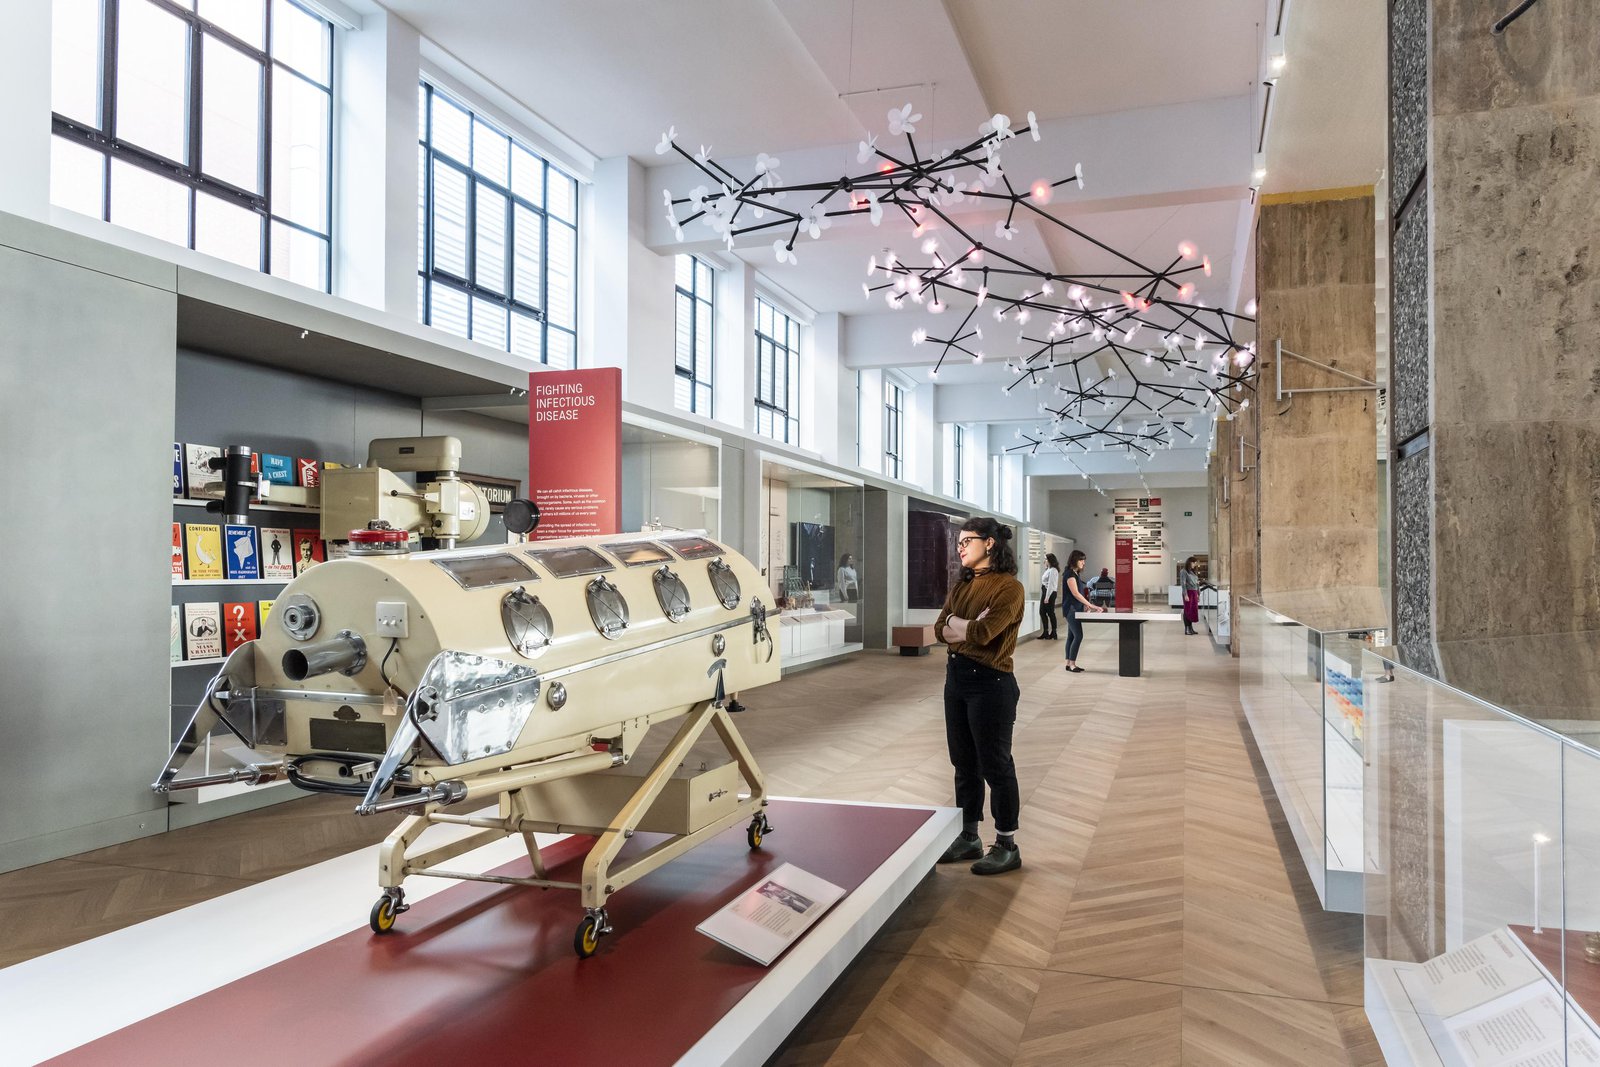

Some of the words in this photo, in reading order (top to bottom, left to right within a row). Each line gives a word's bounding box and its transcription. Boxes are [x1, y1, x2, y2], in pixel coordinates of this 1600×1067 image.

[536, 383, 583, 396] FIGHTING
[536, 395, 595, 409] INFECTIOUS
[536, 409, 579, 422] DISEASE
[270, 457, 284, 466] HAVE
[273, 470, 288, 479] CHEST
[479, 487, 512, 503] TORIUM
